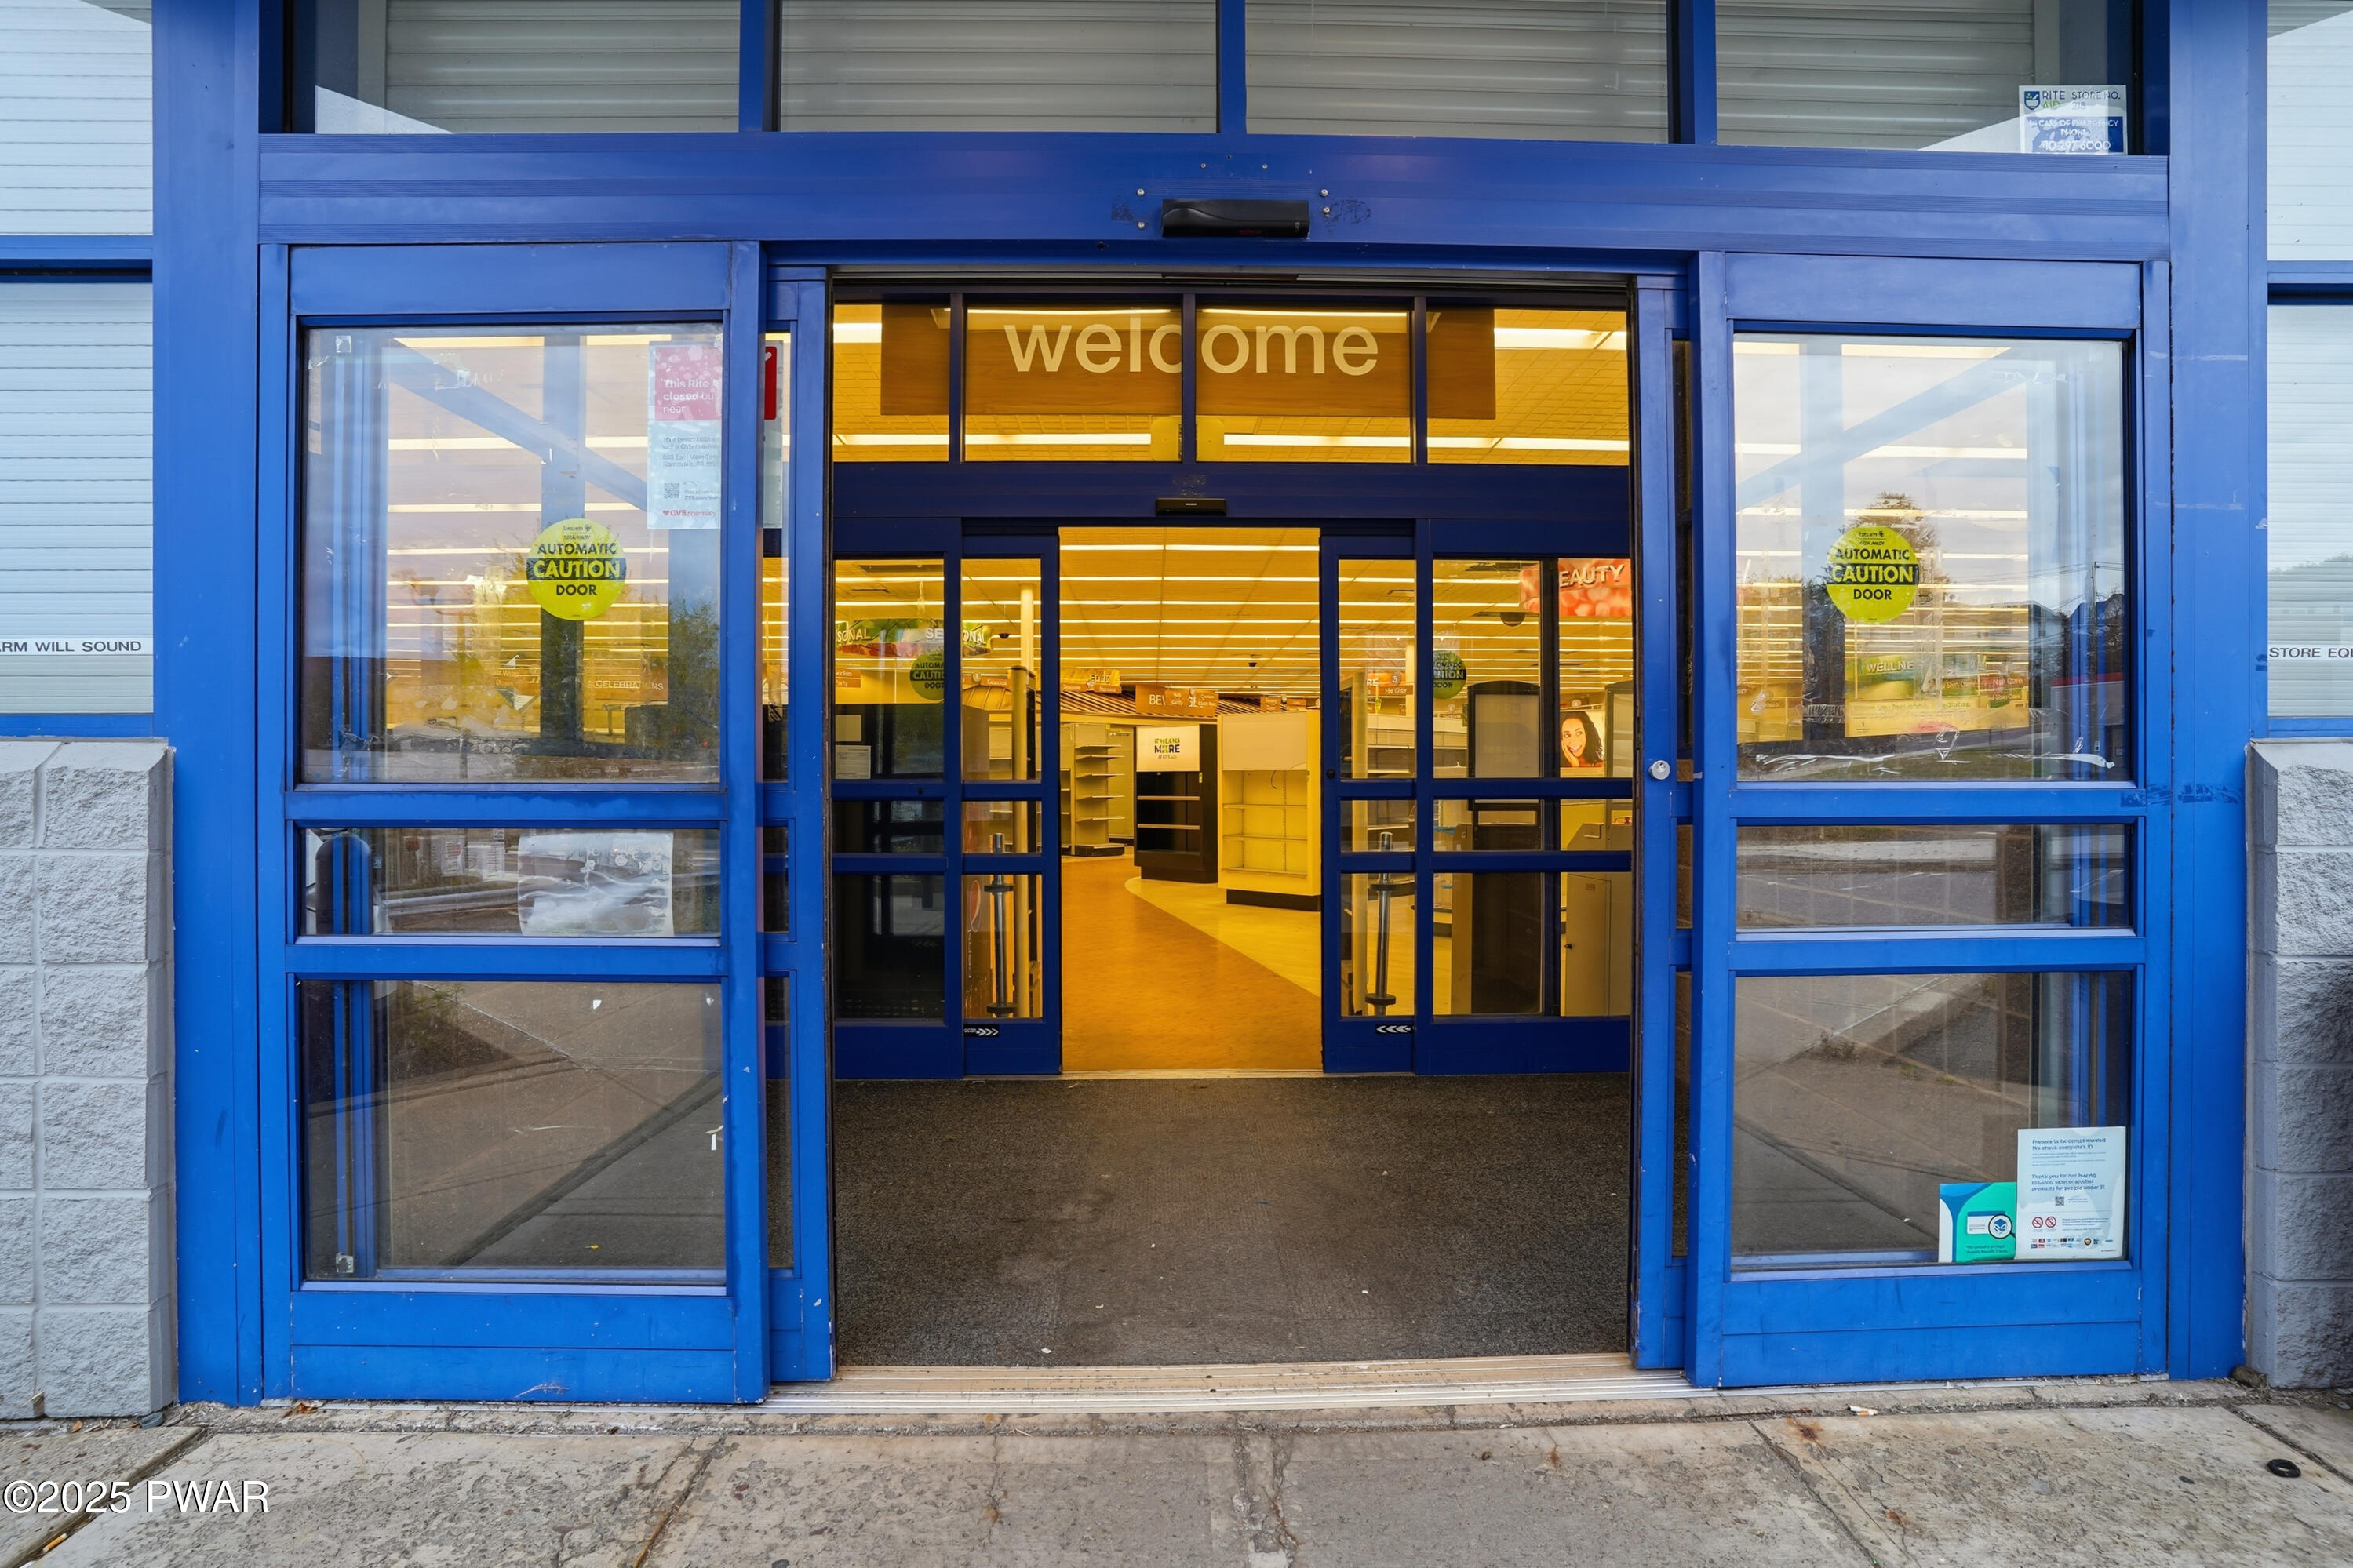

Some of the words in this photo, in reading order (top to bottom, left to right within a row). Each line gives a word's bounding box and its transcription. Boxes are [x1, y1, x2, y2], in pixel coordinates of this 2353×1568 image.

[2042, 90, 2065, 100] RITE
[2071, 91, 2103, 100] STORE
[2104, 91, 2121, 100] NO.
[1003, 307, 1379, 376] welcome
[665, 380, 686, 388] This
[688, 380, 709, 388] Rite
[664, 391, 698, 401] closed
[663, 406, 687, 414] near
[537, 543, 617, 555] AUTOMATIC
[1835, 549, 1910, 560] AUTOMATIC
[534, 559, 621, 578] CAUTION
[1832, 565, 1914, 583] CAUTION
[1558, 564, 1625, 587] EAUTY
[556, 584, 597, 596] DOOR
[1853, 589, 1892, 600] DOOR
[836, 628, 871, 642] SONAL
[0, 642, 27, 653] RM
[35, 642, 75, 652] WILL
[82, 641, 142, 653] SOUND
[2269, 647, 2322, 658] STORE
[2328, 647, 2353, 658] EQ
[1867, 660, 1914, 672] WELLNE
